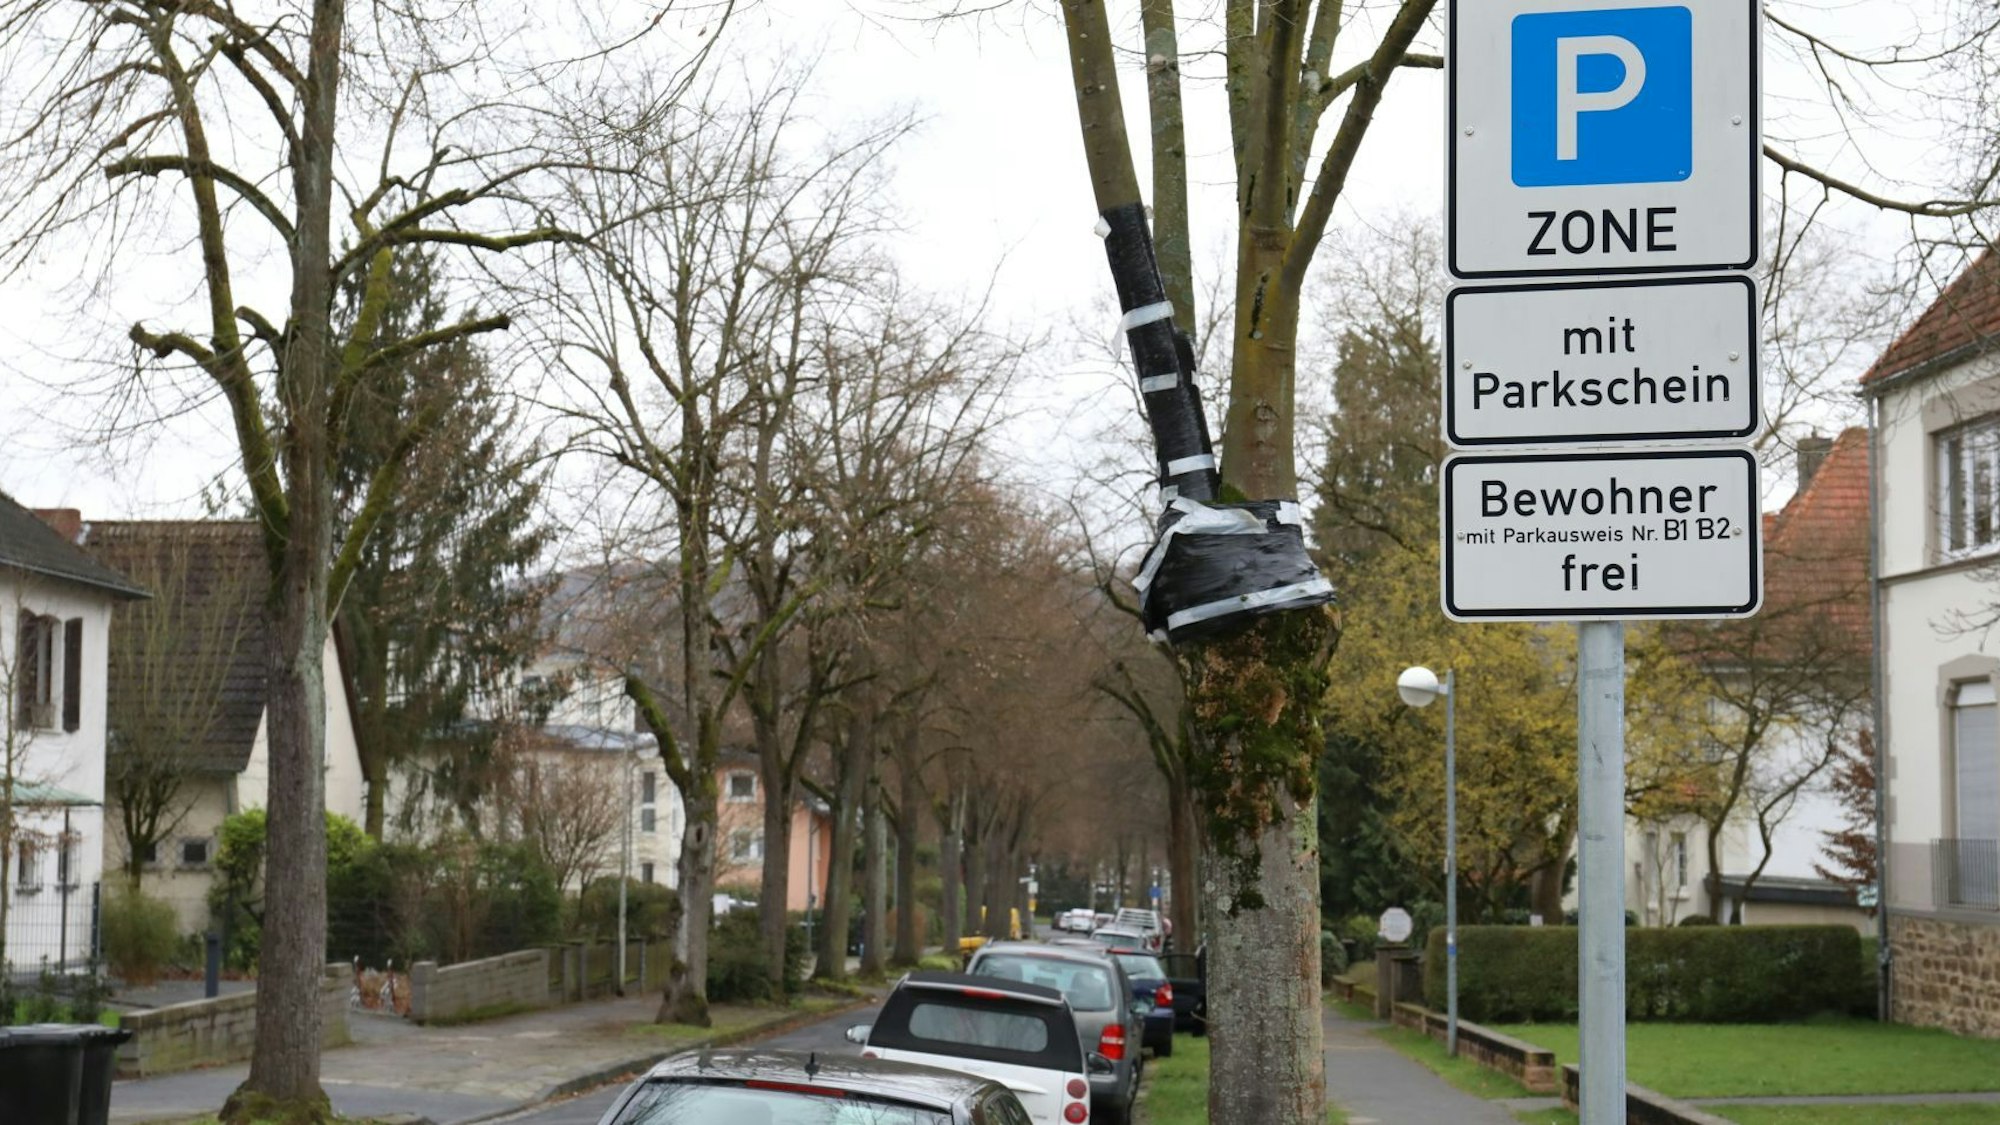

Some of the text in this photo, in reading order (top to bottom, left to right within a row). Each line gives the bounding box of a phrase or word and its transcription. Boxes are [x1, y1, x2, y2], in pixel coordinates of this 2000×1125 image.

[1556, 35, 1646, 161] P
[1527, 207, 1677, 256] ZONE
[1563, 316, 1635, 355] mit
[1473, 366, 1730, 410] Parkschein
[1481, 478, 1717, 518] Bewohner
[1466, 528, 1495, 544] mit
[1504, 527, 1624, 544] Parkausweis
[1632, 525, 1658, 541] Nr.
[1664, 519, 1687, 541] B1
[1561, 553, 1638, 591] frei
